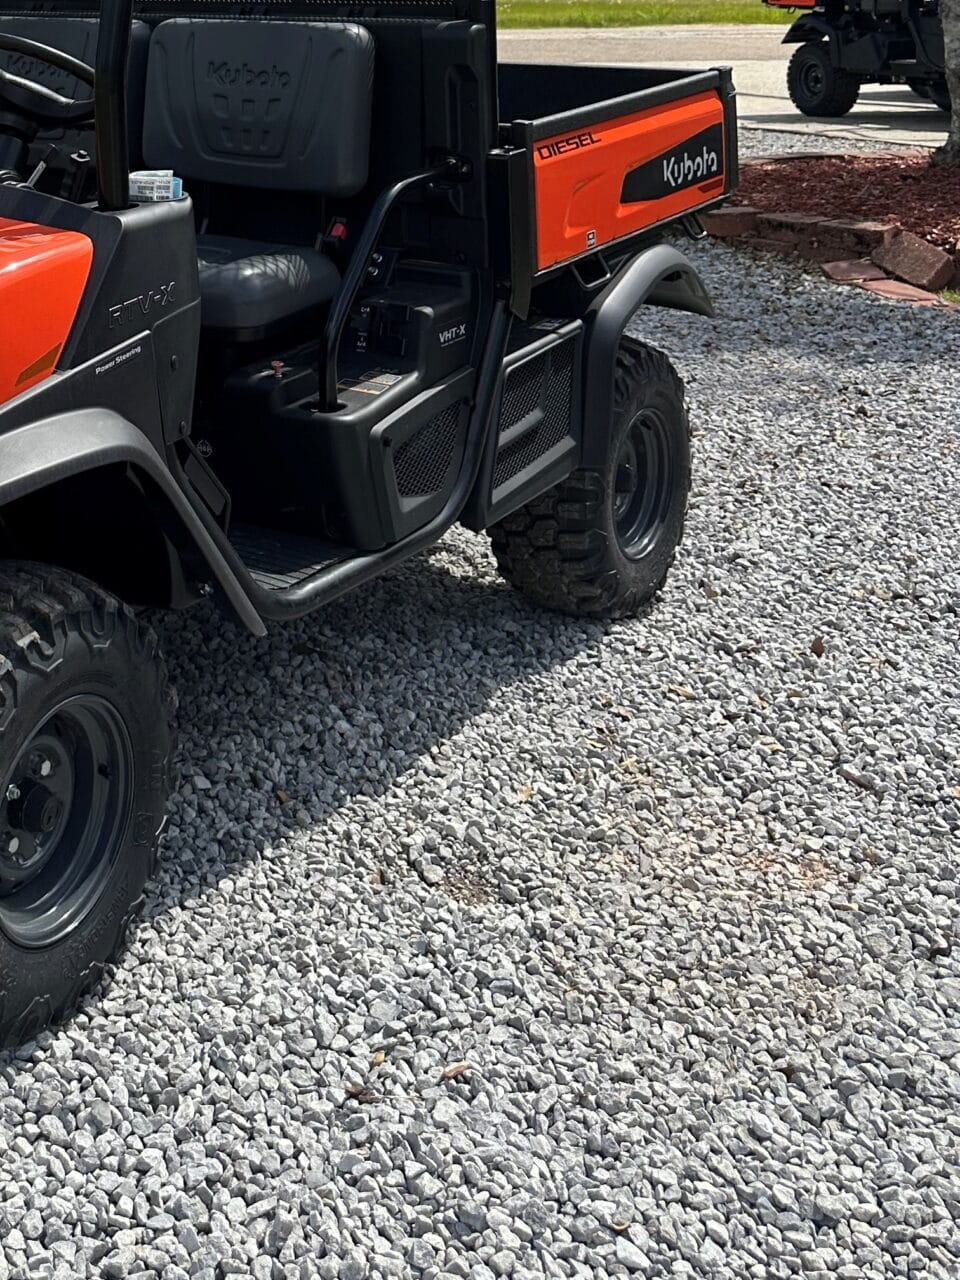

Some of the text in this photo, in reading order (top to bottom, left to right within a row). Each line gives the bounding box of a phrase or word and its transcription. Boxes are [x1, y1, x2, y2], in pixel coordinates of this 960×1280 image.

[206, 60, 292, 89] Kubota
[537, 131, 602, 161] DIESEL
[663, 145, 718, 187] Kubota
[108, 281, 176, 329] RTV-X
[438, 323, 467, 343] VHT-X
[95, 345, 142, 375] Power Steering
